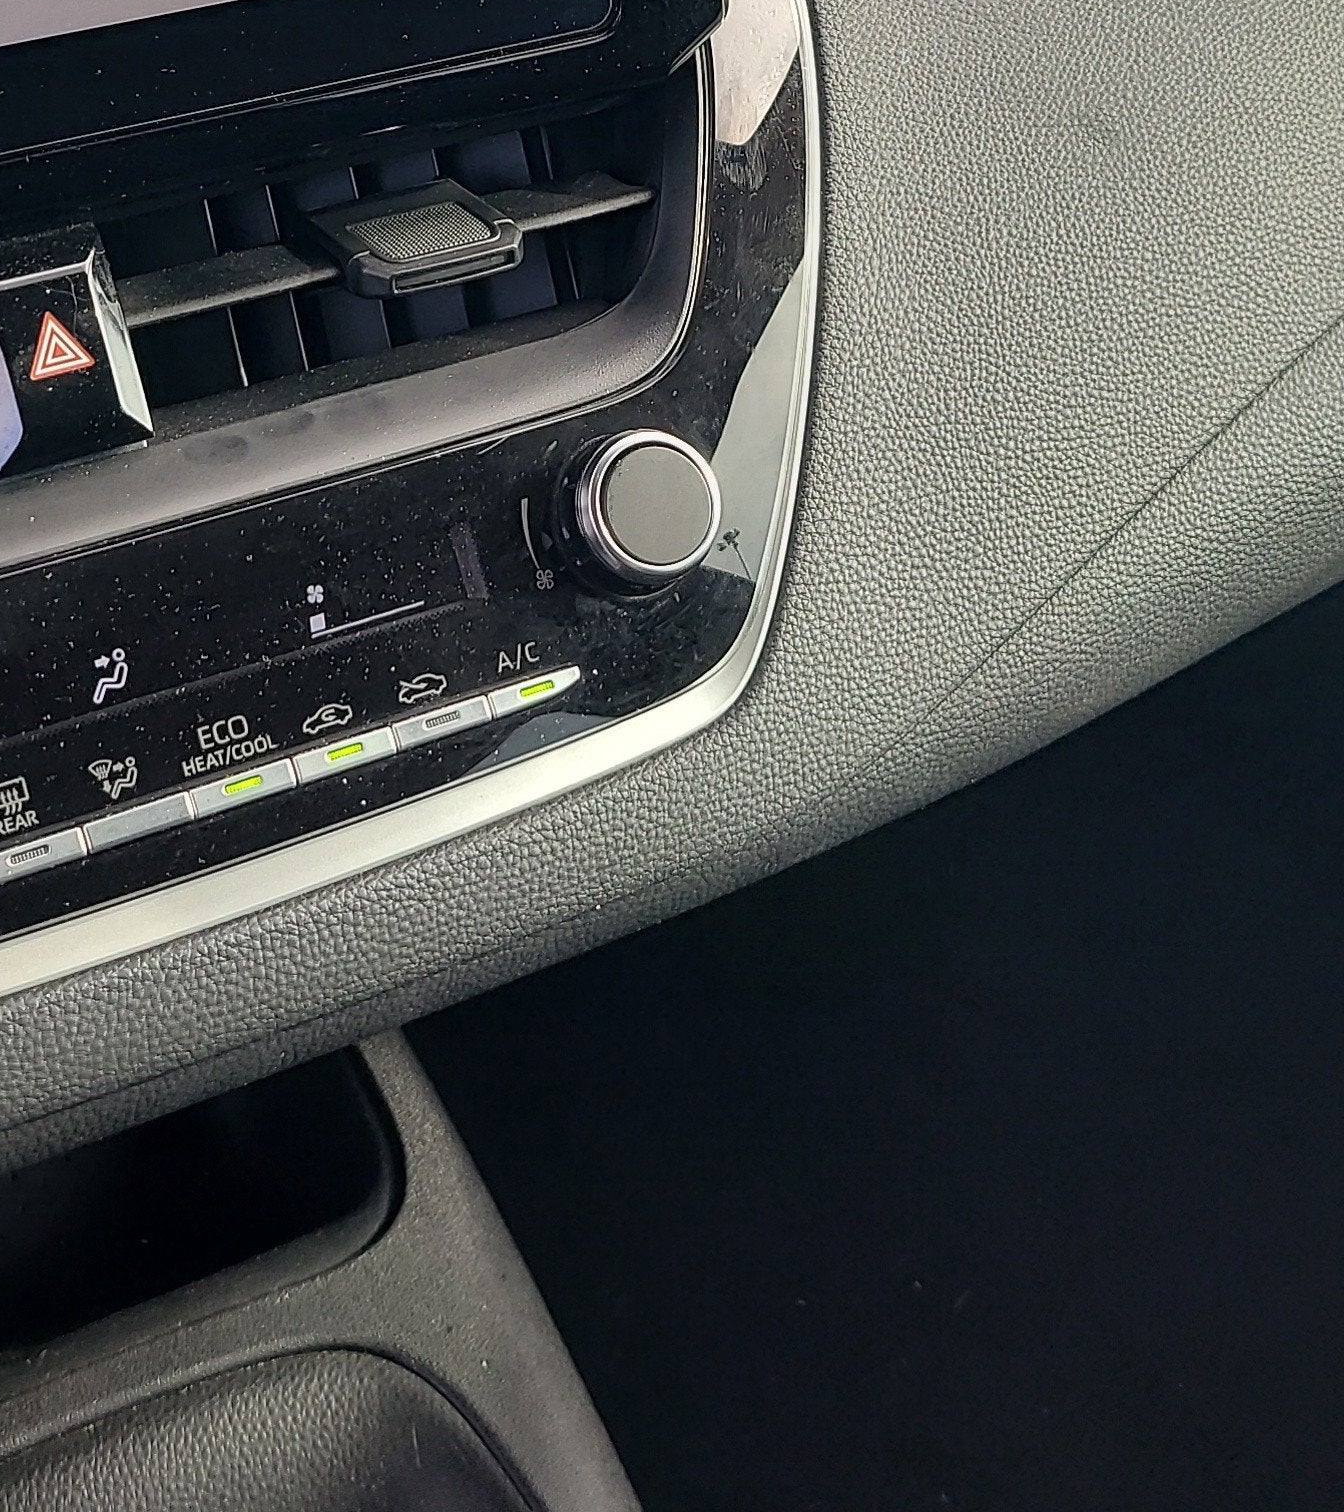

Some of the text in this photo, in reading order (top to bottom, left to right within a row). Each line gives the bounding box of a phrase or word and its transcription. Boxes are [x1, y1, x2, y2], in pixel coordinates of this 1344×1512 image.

[497, 642, 540, 673] A/C
[197, 714, 250, 752] ECO
[181, 734, 279, 777] HEAT/COOL
